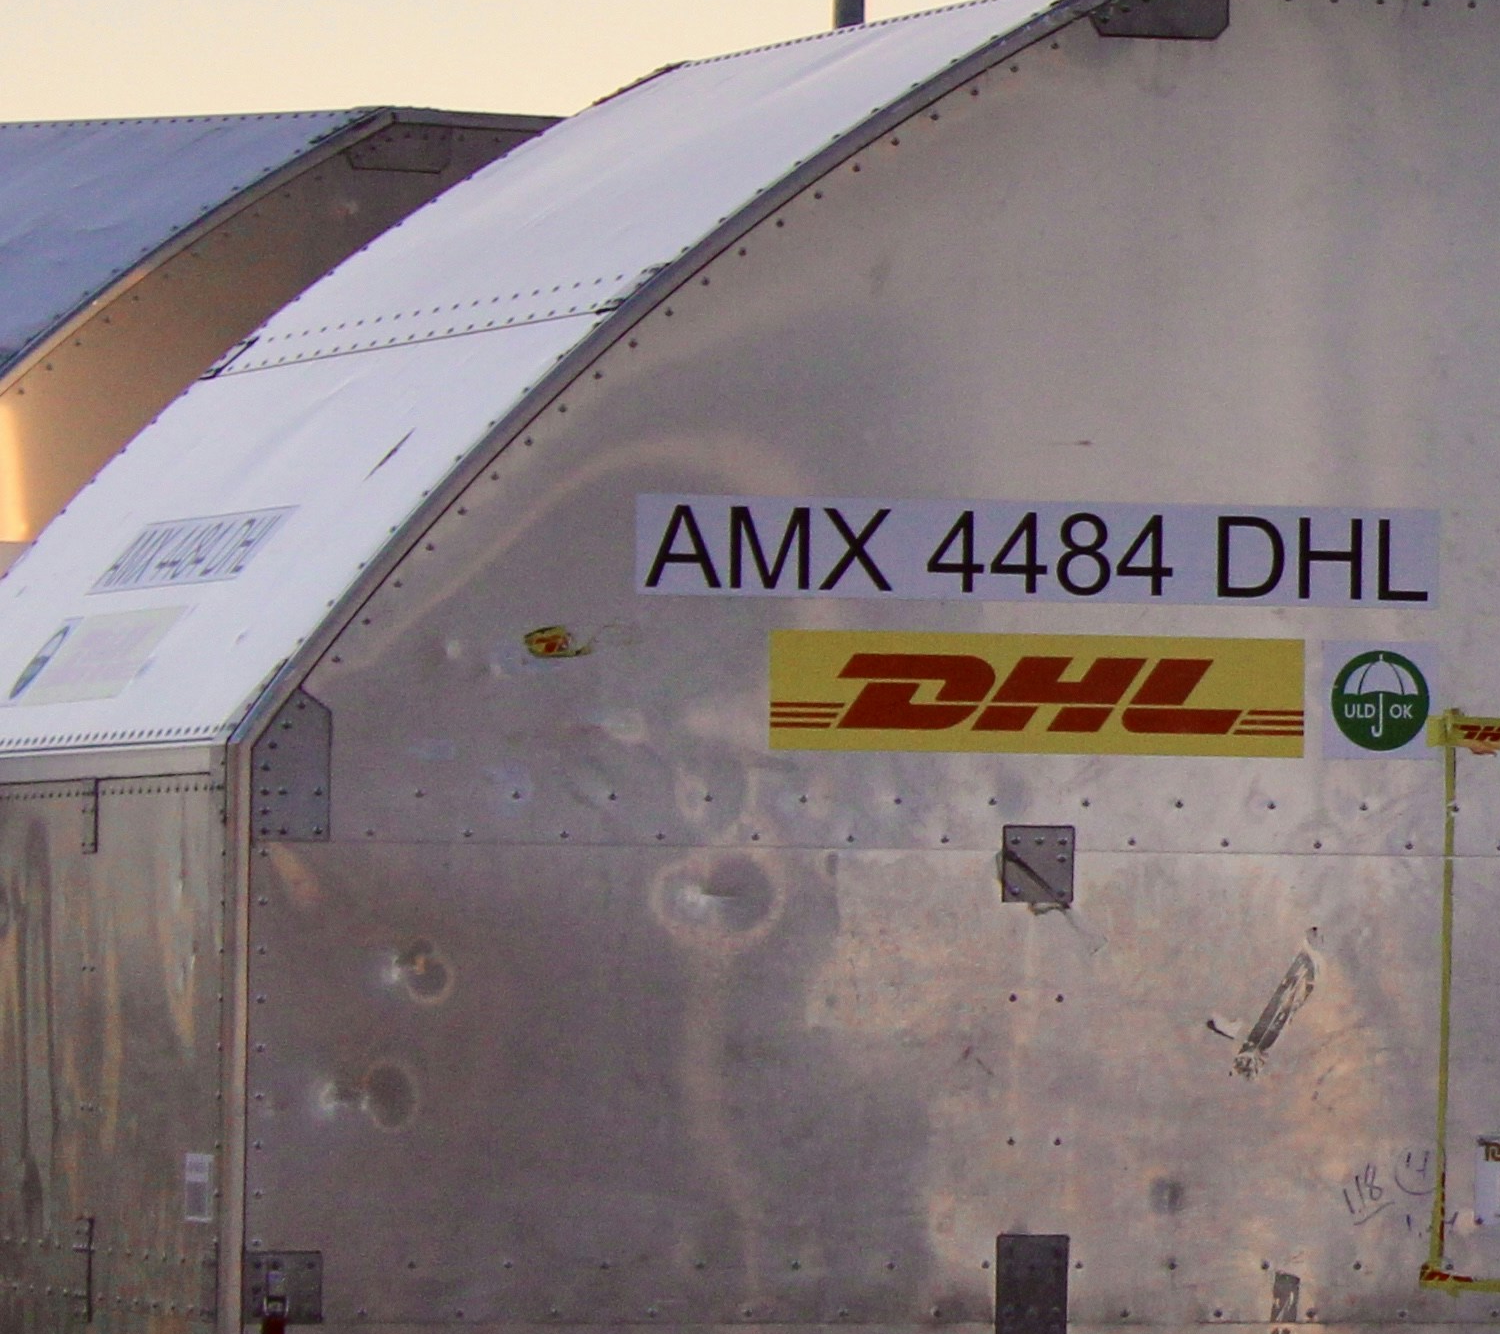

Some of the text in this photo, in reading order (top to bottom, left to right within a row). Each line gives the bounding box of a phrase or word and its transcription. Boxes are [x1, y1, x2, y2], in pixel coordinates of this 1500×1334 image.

[646, 504, 1429, 602] AMX 4484 DHL
[837, 653, 1242, 736] DHL
[1344, 703, 1413, 719] ULD OK
